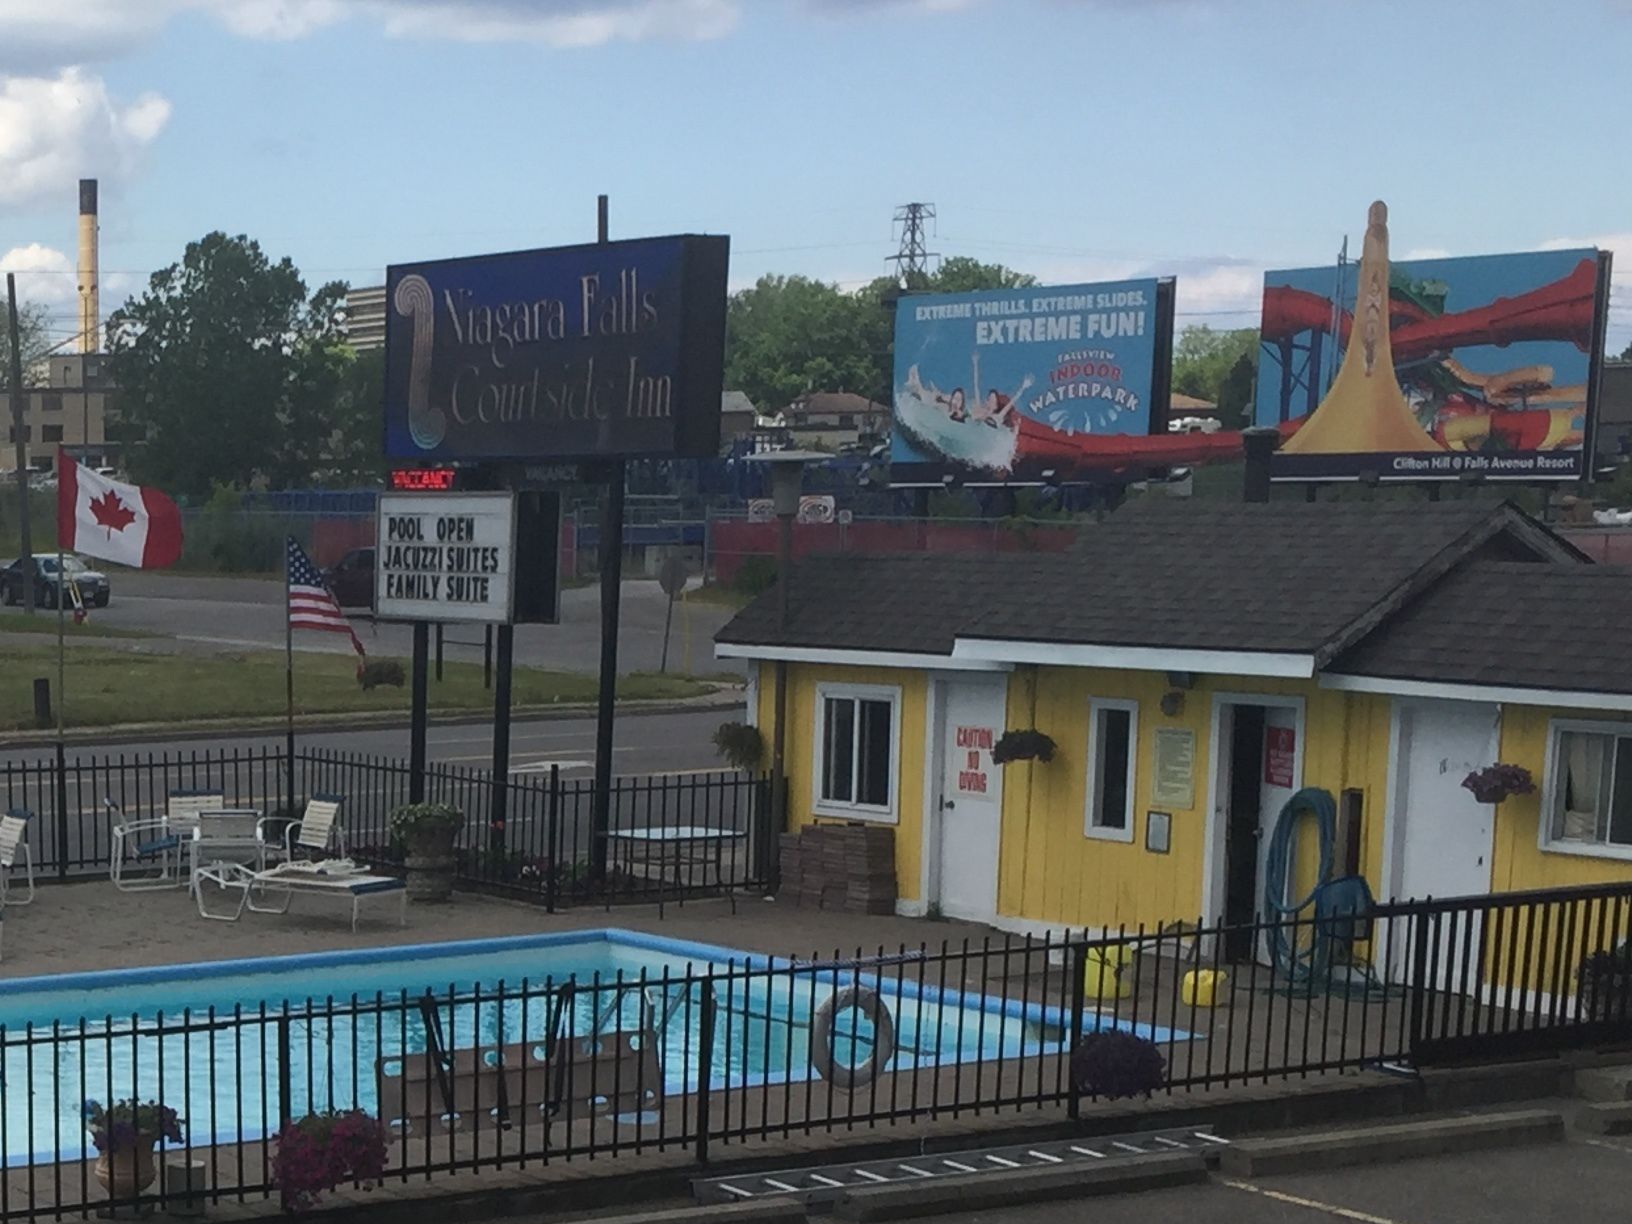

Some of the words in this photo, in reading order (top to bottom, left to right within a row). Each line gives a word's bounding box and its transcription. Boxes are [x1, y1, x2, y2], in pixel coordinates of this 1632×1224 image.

[444, 287, 565, 368] Niagara
[580, 267, 658, 338] Falls
[916, 303, 971, 321] EXTREME
[974, 300, 1029, 317] THRILLS.
[1032, 294, 1093, 313] EXTREME
[1096, 291, 1148, 308] SLIDES.
[976, 315, 1081, 345] EXTREME
[1087, 311, 1145, 339] FUN!
[1057, 350, 1116, 363] FALLSVIEW
[1049, 362, 1122, 384] INDOOR
[451, 356, 615, 425] Courtside
[626, 356, 672, 418] Inn
[1029, 382, 1140, 413] WATERPARK
[1393, 456, 1429, 470] Clifton
[1432, 456, 1450, 469] Hill
[1464, 456, 1489, 469] Falls
[1491, 456, 1534, 469] Avenue
[1536, 456, 1575, 469] Resort
[388, 517, 424, 541] POOL
[437, 517, 474, 541] OPEN
[383, 545, 443, 571] JACUZZI
[446, 546, 499, 573] SUITES
[386, 573, 441, 600] FAMILY
[446, 576, 489, 602] SUITE
[956, 727, 993, 749] CAUTION
